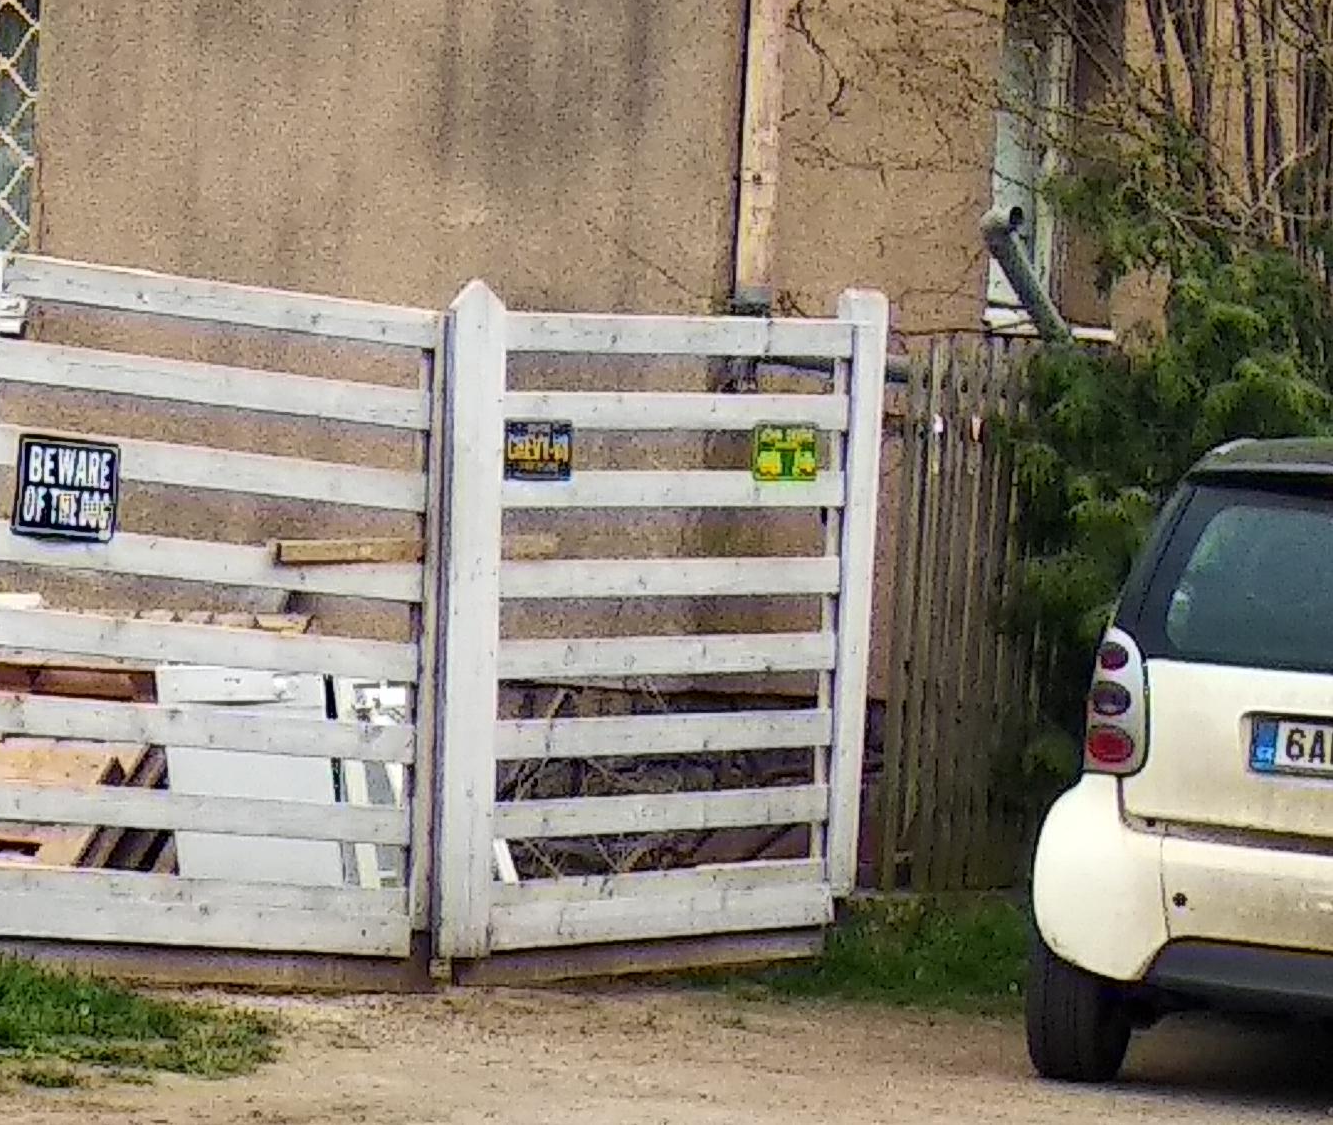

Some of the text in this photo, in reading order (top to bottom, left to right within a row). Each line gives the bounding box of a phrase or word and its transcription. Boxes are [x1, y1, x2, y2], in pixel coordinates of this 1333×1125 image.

[28, 445, 112, 490] BEWARE
[23, 485, 48, 523] OF
[49, 487, 80, 527] THE
[1285, 728, 1333, 764] 6A
